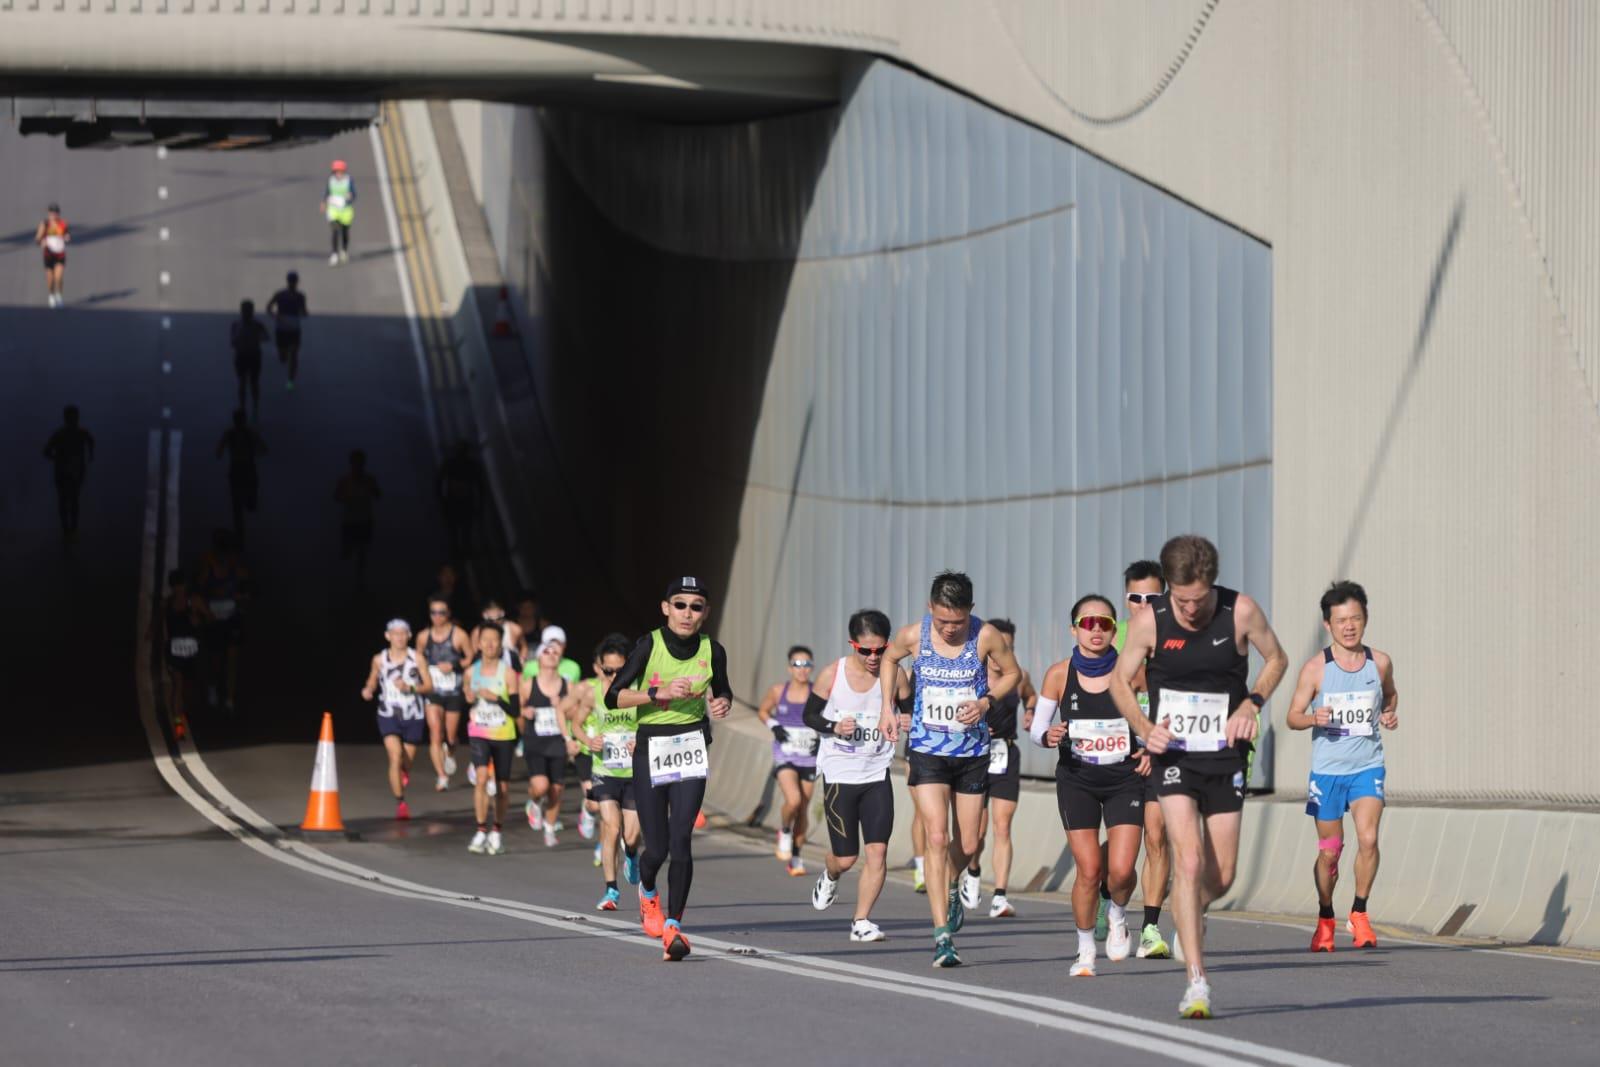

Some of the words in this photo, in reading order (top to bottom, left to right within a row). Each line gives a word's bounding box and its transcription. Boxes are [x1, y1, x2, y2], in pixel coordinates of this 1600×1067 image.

[920, 666, 976, 679] SOUTHRUN
[1329, 708, 1373, 725] 11092
[653, 749, 704, 771] 14098
